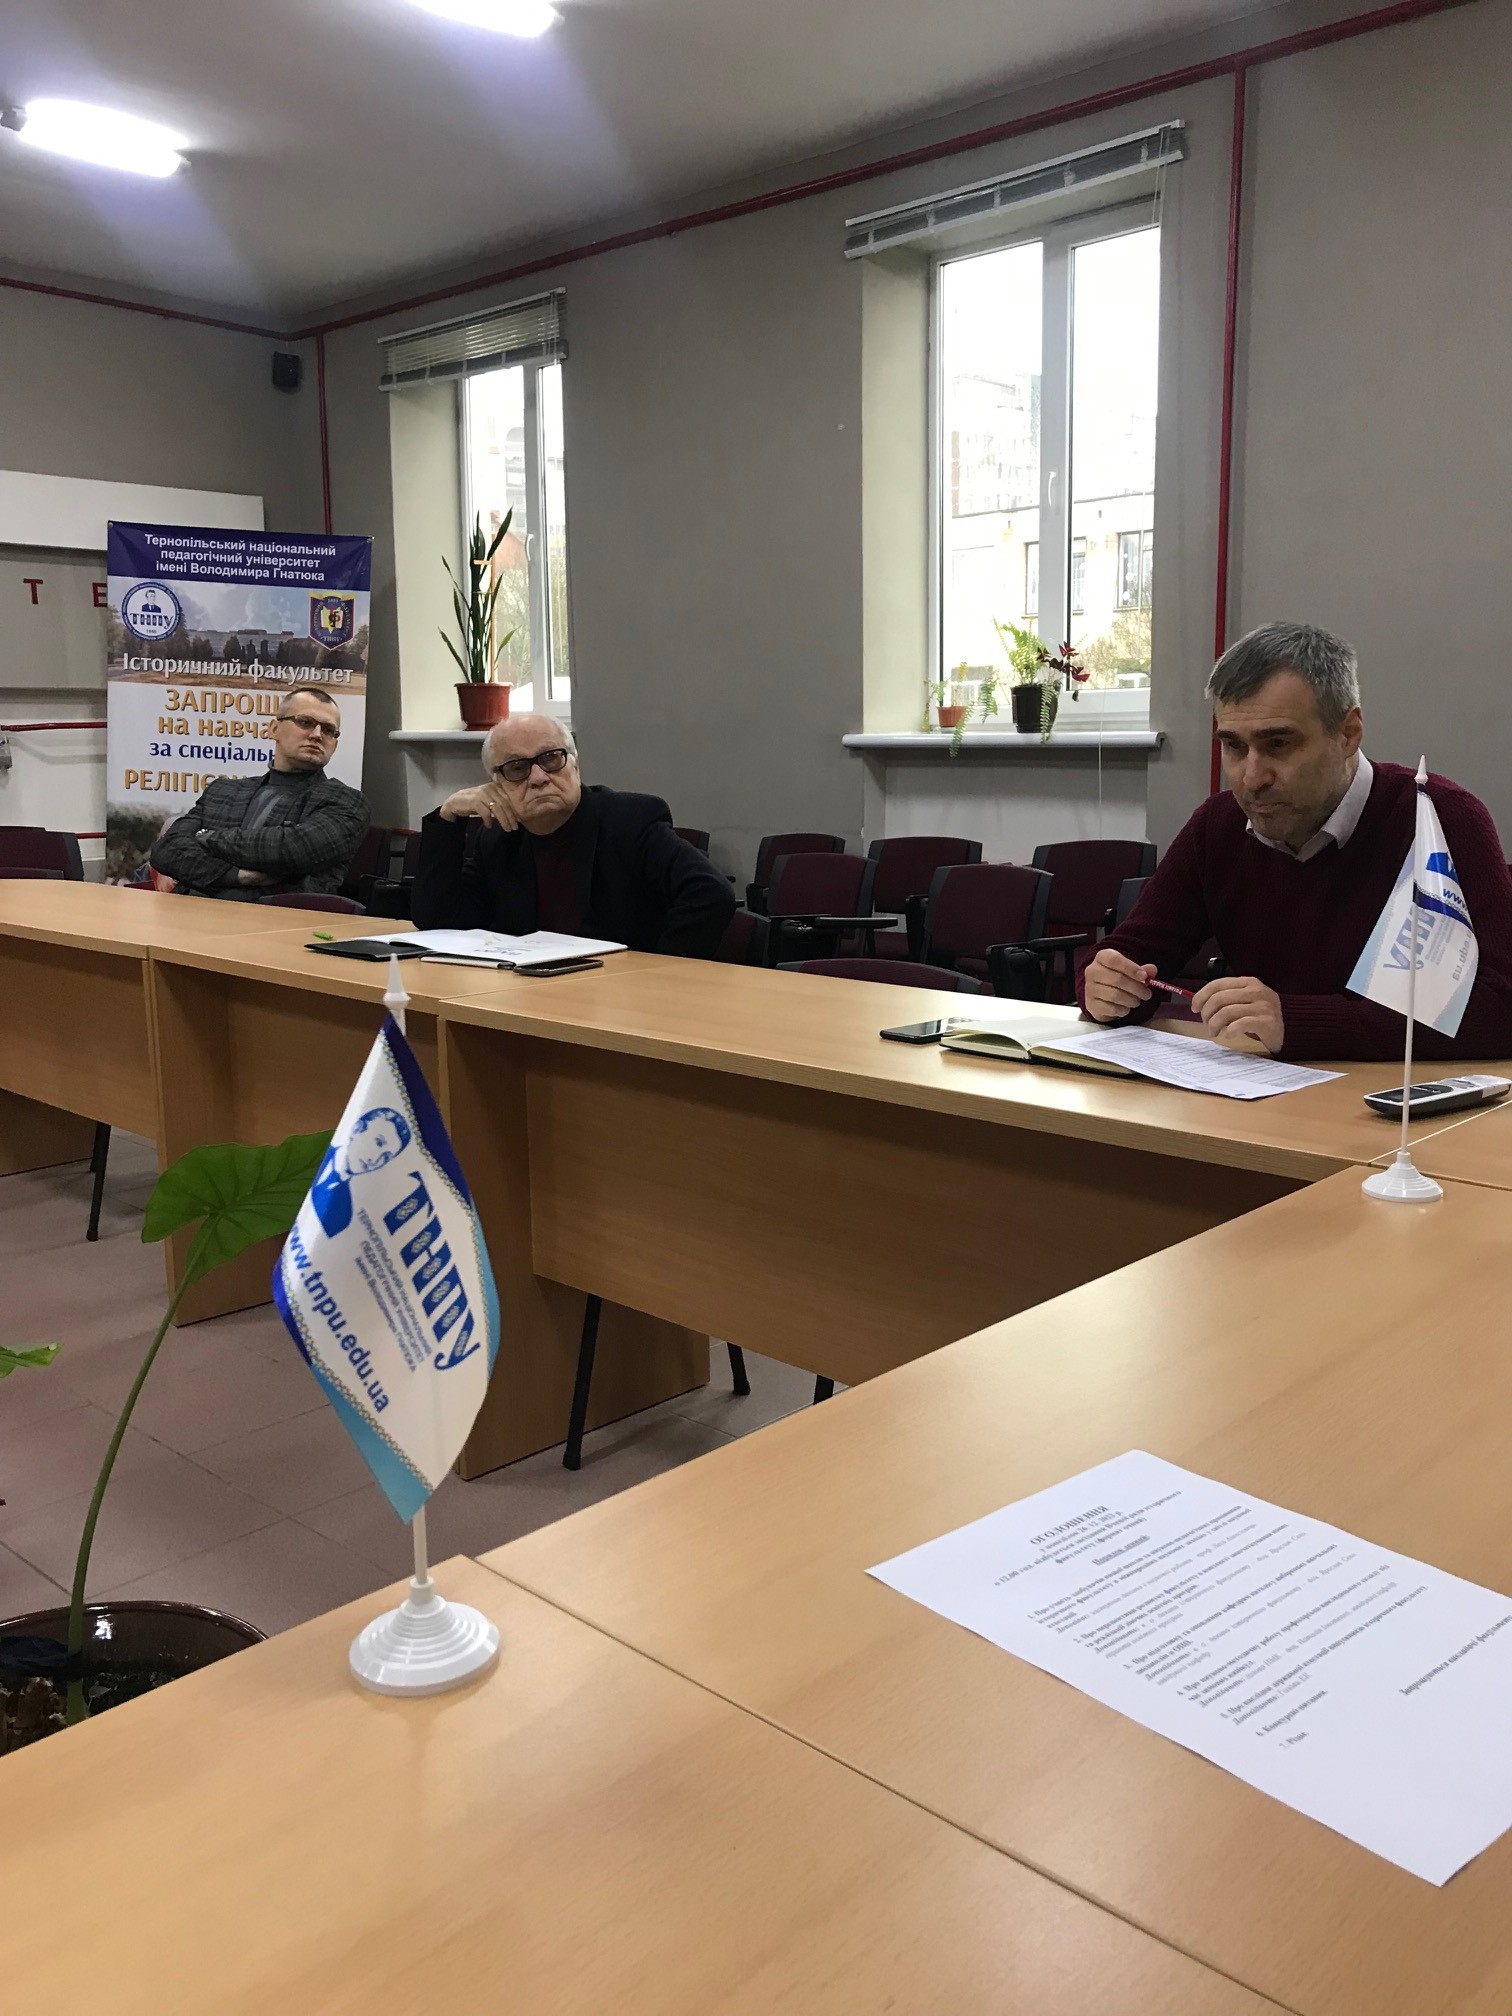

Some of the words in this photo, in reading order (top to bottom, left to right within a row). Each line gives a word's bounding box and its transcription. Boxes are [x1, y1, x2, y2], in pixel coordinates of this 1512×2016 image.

[145, 534, 246, 551] Тернопільський
[249, 542, 336, 557] національний
[160, 550, 243, 563] педагогічний
[246, 554, 320, 568] університет
[156, 561, 187, 573] імені
[190, 563, 270, 579] Володимира
[273, 568, 325, 581] Гнатюка
[130, 613, 174, 630] ТНПУ
[123, 653, 241, 678] Історичний
[249, 658, 353, 685] факультет
[165, 688, 279, 716] ЗАПРОШ
[158, 717, 189, 736] на
[198, 718, 270, 739] навча
[150, 742, 172, 757] за
[179, 742, 275, 763] спеціальн
[124, 769, 243, 793] РЕЛІГІЄ
[383, 1171, 481, 1371] ТНПУ
